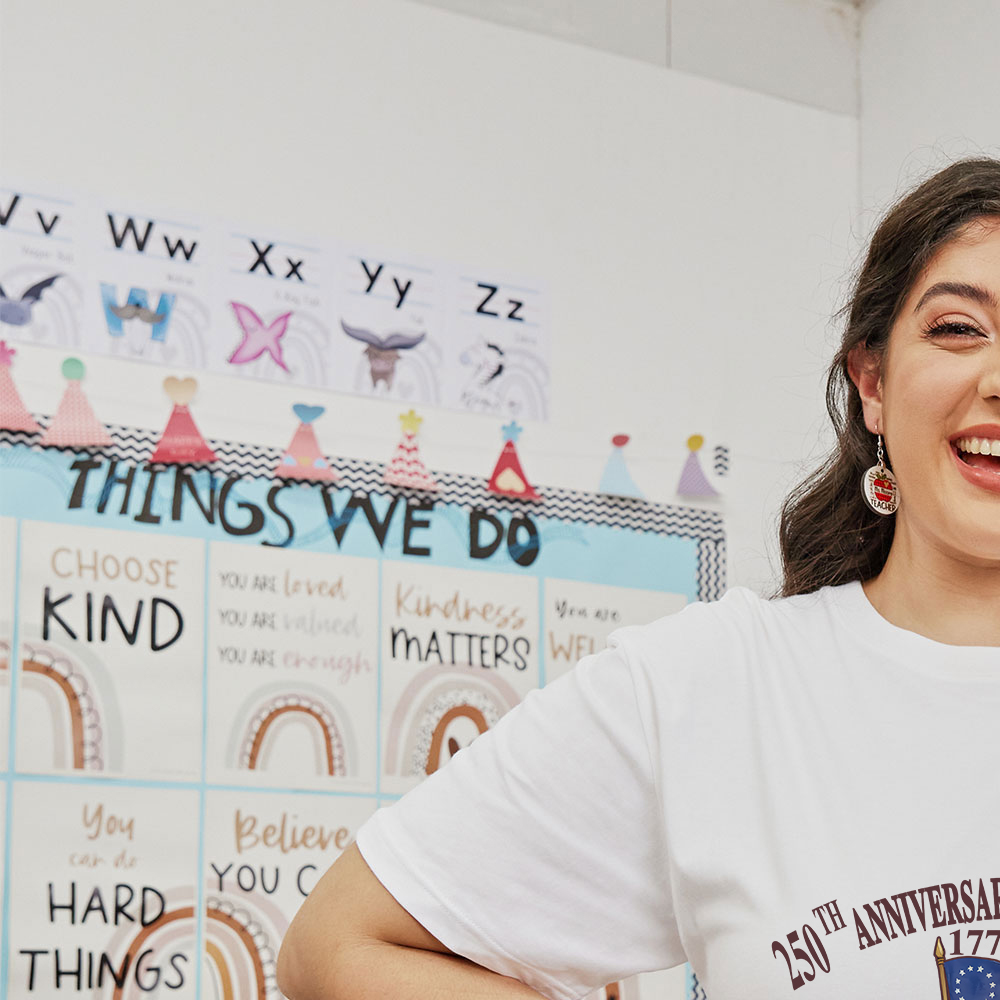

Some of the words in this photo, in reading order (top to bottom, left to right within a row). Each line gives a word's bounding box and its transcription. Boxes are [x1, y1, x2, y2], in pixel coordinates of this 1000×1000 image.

[107, 212, 154, 253] W
[248, 239, 274, 276] X
[360, 258, 384, 294] Y
[475, 281, 499, 317] Z
[67, 459, 295, 549] THINGS
[319, 485, 435, 557] WE
[468, 509, 540, 567] DO
[50, 547, 179, 589] CHOOSE
[217, 571, 248, 589] YOU
[252, 574, 278, 594] ARE
[283, 571, 347, 601] loved
[42, 585, 185, 652] KIND
[217, 609, 248, 628] YOU
[251, 611, 277, 631] ARE
[283, 610, 363, 641] valued
[394, 581, 529, 631] Kindness
[555, 599, 590, 624] You
[216, 646, 247, 665] YOU
[251, 648, 276, 669] ARE
[282, 649, 376, 685] enough
[390, 625, 532, 673] MATTERS
[82, 801, 136, 841] You
[234, 808, 350, 855] Believe
[69, 852, 105, 869] can
[112, 849, 138, 870] do
[210, 861, 280, 895] YOU
[47, 880, 167, 928] HARD
[18, 946, 190, 993] THINGS
